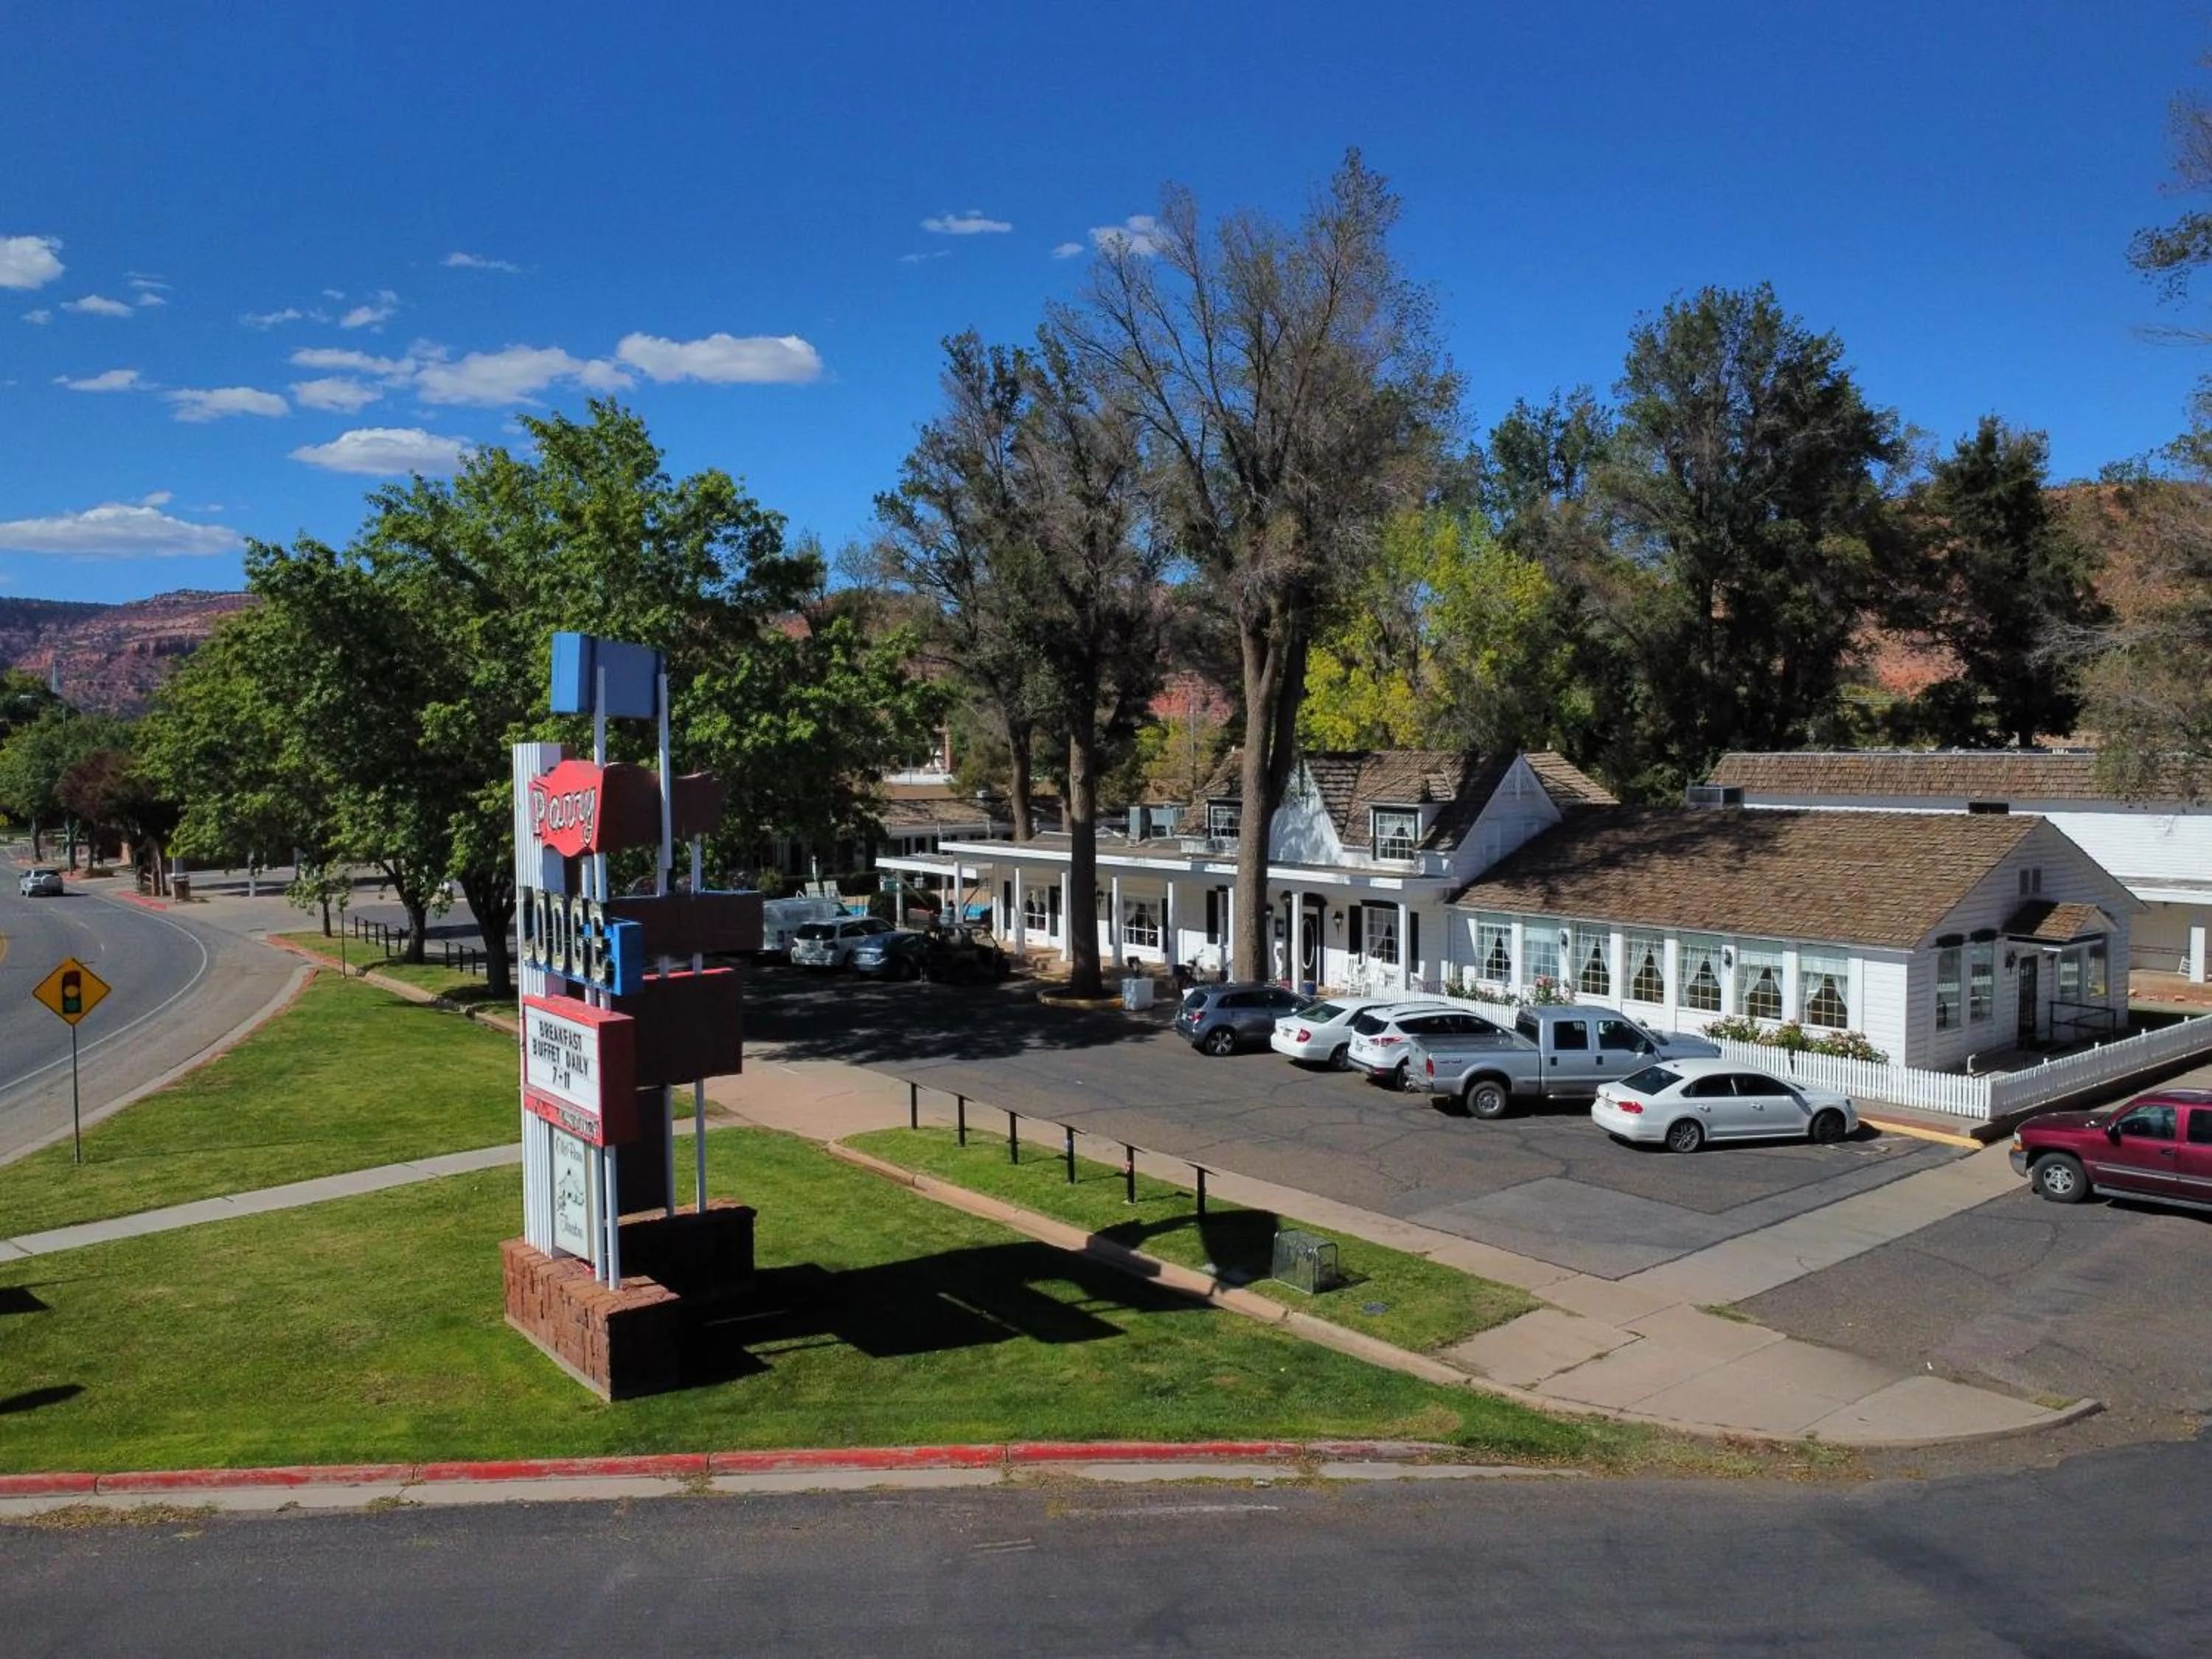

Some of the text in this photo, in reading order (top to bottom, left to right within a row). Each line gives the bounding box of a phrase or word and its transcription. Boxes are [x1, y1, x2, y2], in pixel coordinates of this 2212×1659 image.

[532, 788, 596, 844] Parry
[518, 886, 609, 984] LODGE
[539, 1020, 582, 1052] BREAKFAST
[532, 1037, 589, 1077] BUFFET DAILY
[552, 1065, 571, 1090] 7-11
